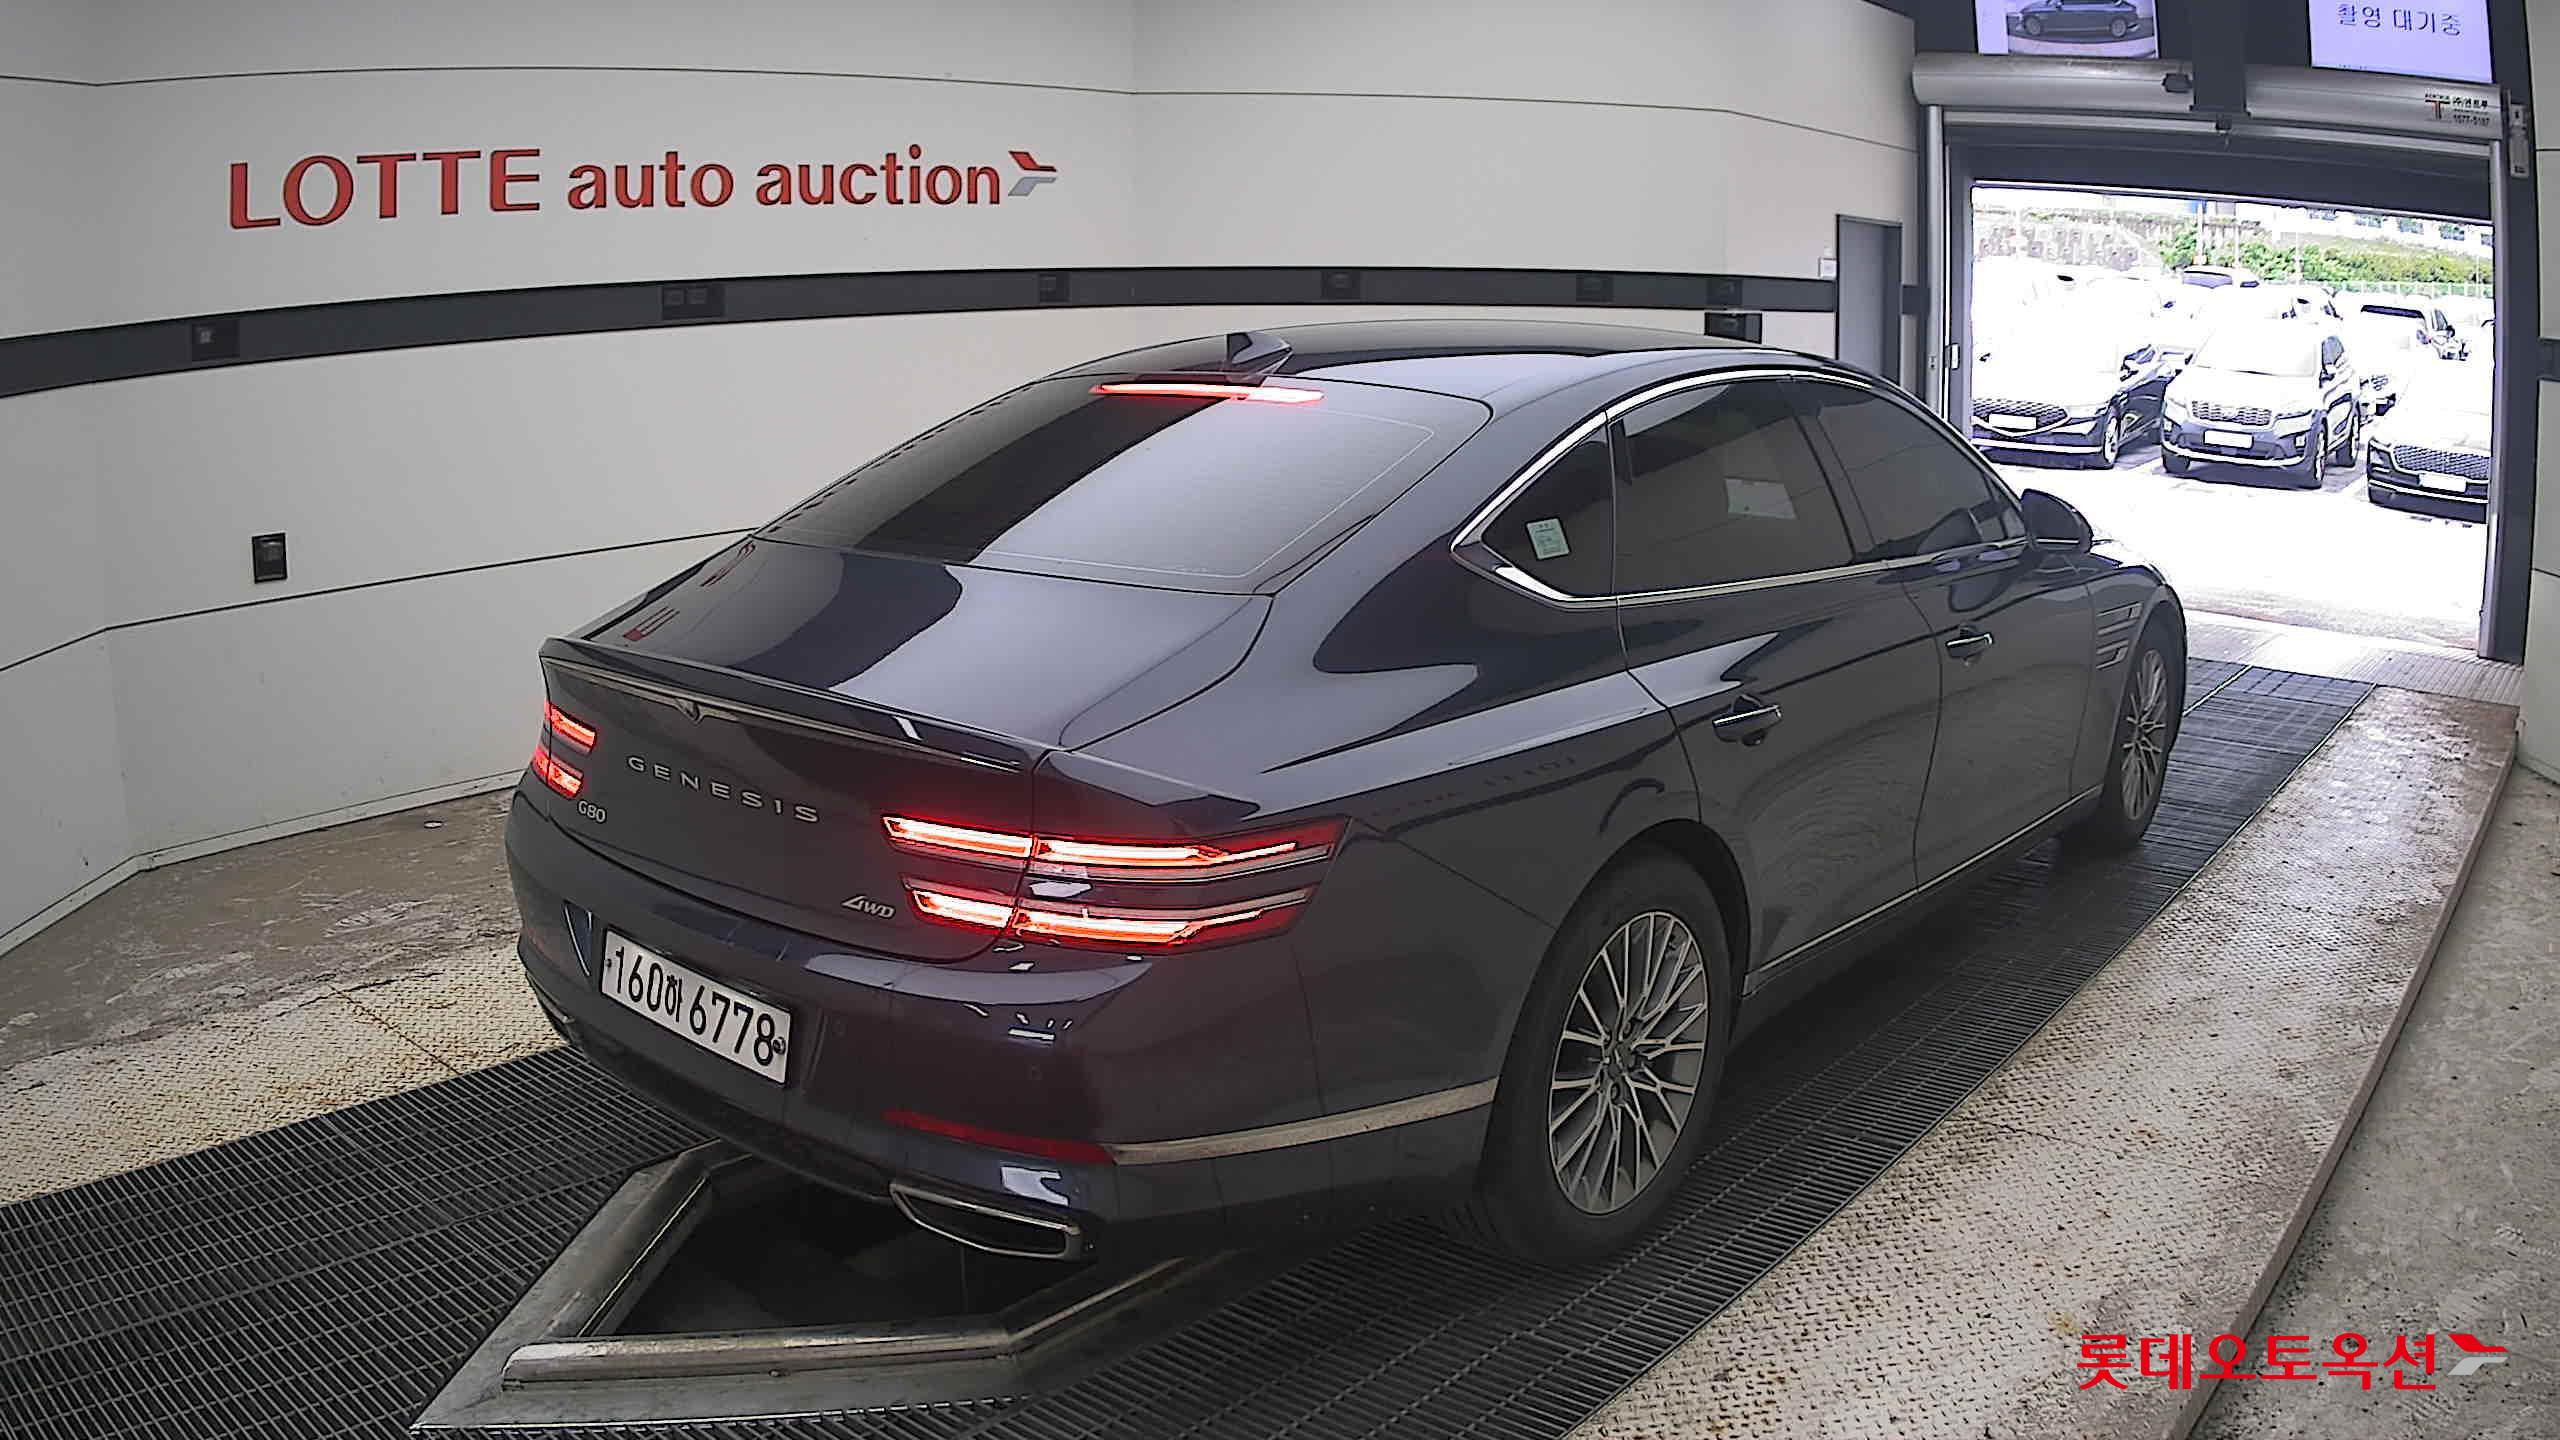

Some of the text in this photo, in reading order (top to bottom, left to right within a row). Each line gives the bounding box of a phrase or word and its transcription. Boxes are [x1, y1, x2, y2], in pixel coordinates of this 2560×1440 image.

[2338, 4, 2461, 36] 촬영 대기중
[229, 144, 1002, 230] LOTTE auto auction
[577, 800, 607, 824] G80
[627, 756, 820, 823] GENESIS
